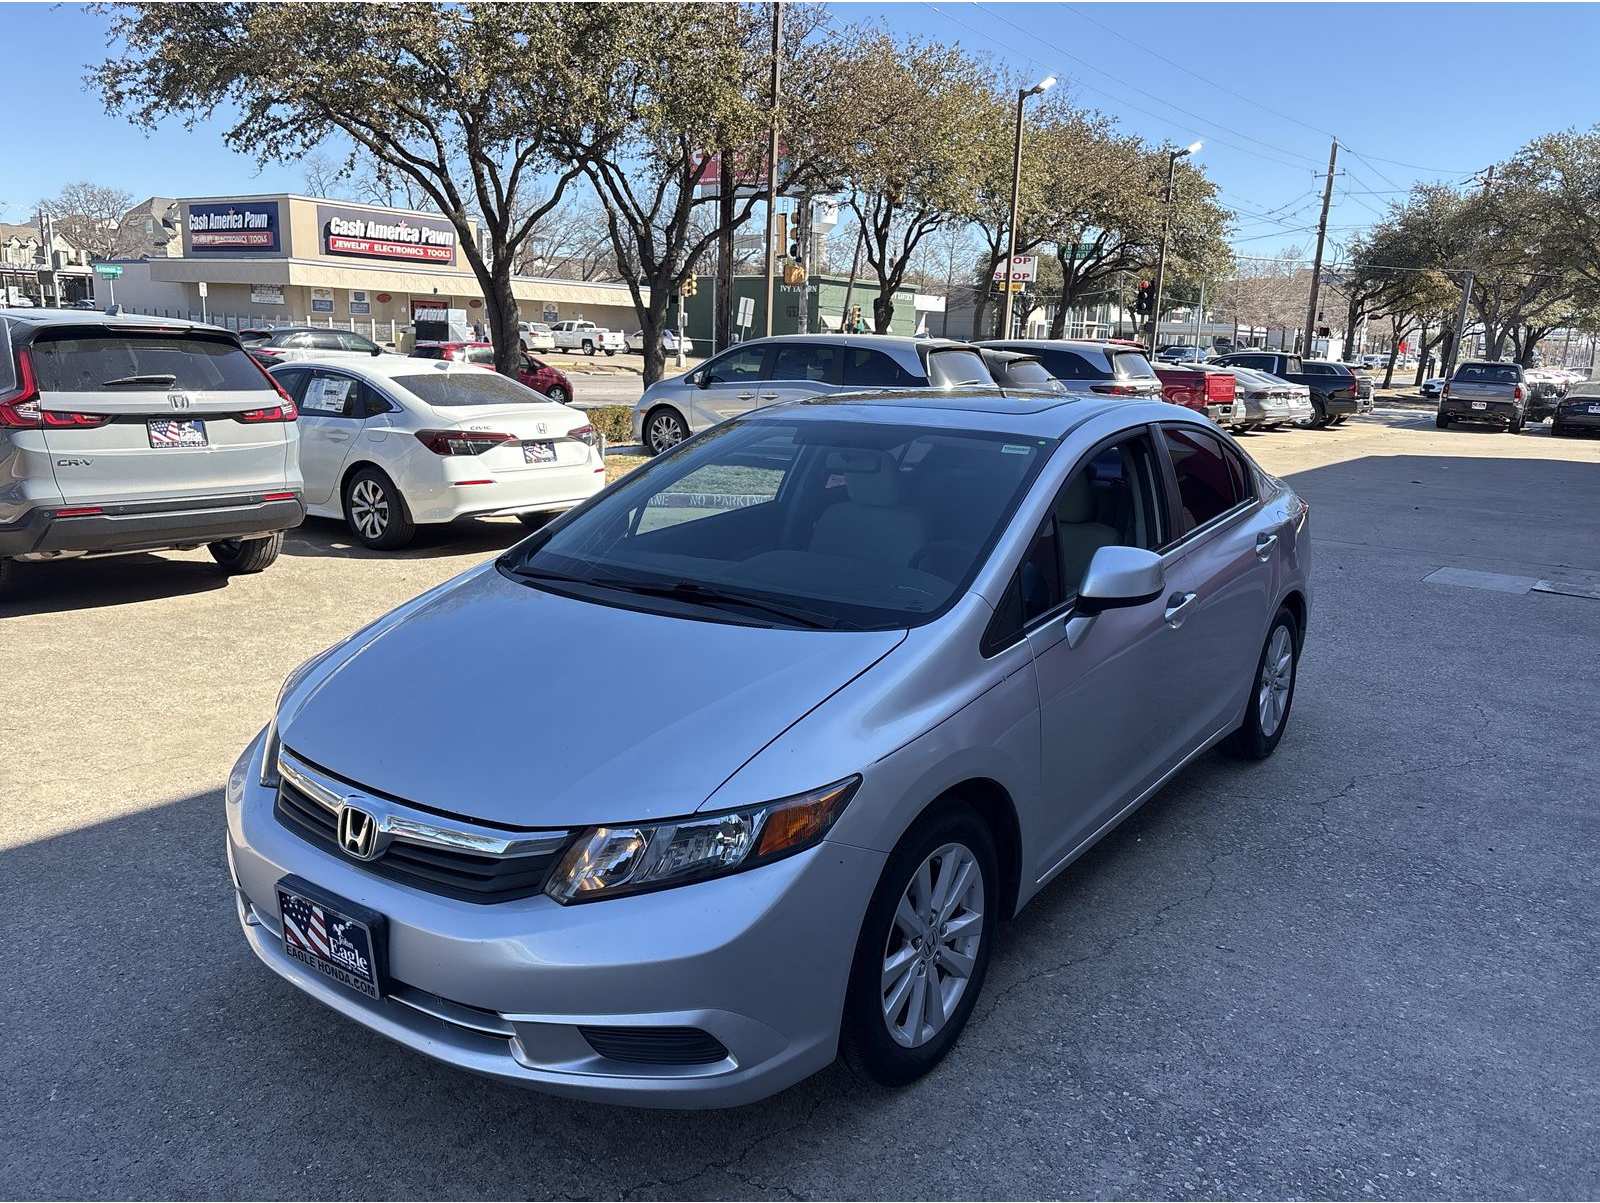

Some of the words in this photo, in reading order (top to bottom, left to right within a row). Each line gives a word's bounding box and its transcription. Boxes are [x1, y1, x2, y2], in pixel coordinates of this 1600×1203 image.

[189, 213, 209, 231] Cash
[209, 211, 243, 230] America
[244, 211, 268, 229] Pawn
[330, 216, 366, 237] Cash
[366, 221, 420, 243] America
[421, 226, 454, 246] Pawn
[250, 234, 268, 243] TOOLS
[334, 239, 370, 251] JEWELRY
[374, 243, 424, 256] ELECTRONICS
[427, 249, 451, 258] TOOLS
[689, 494, 706, 506] NO
[329, 936, 368, 971] Eagle
[287, 945, 317, 968] EAGLE
[317, 960, 376, 997] HONDA.COM
